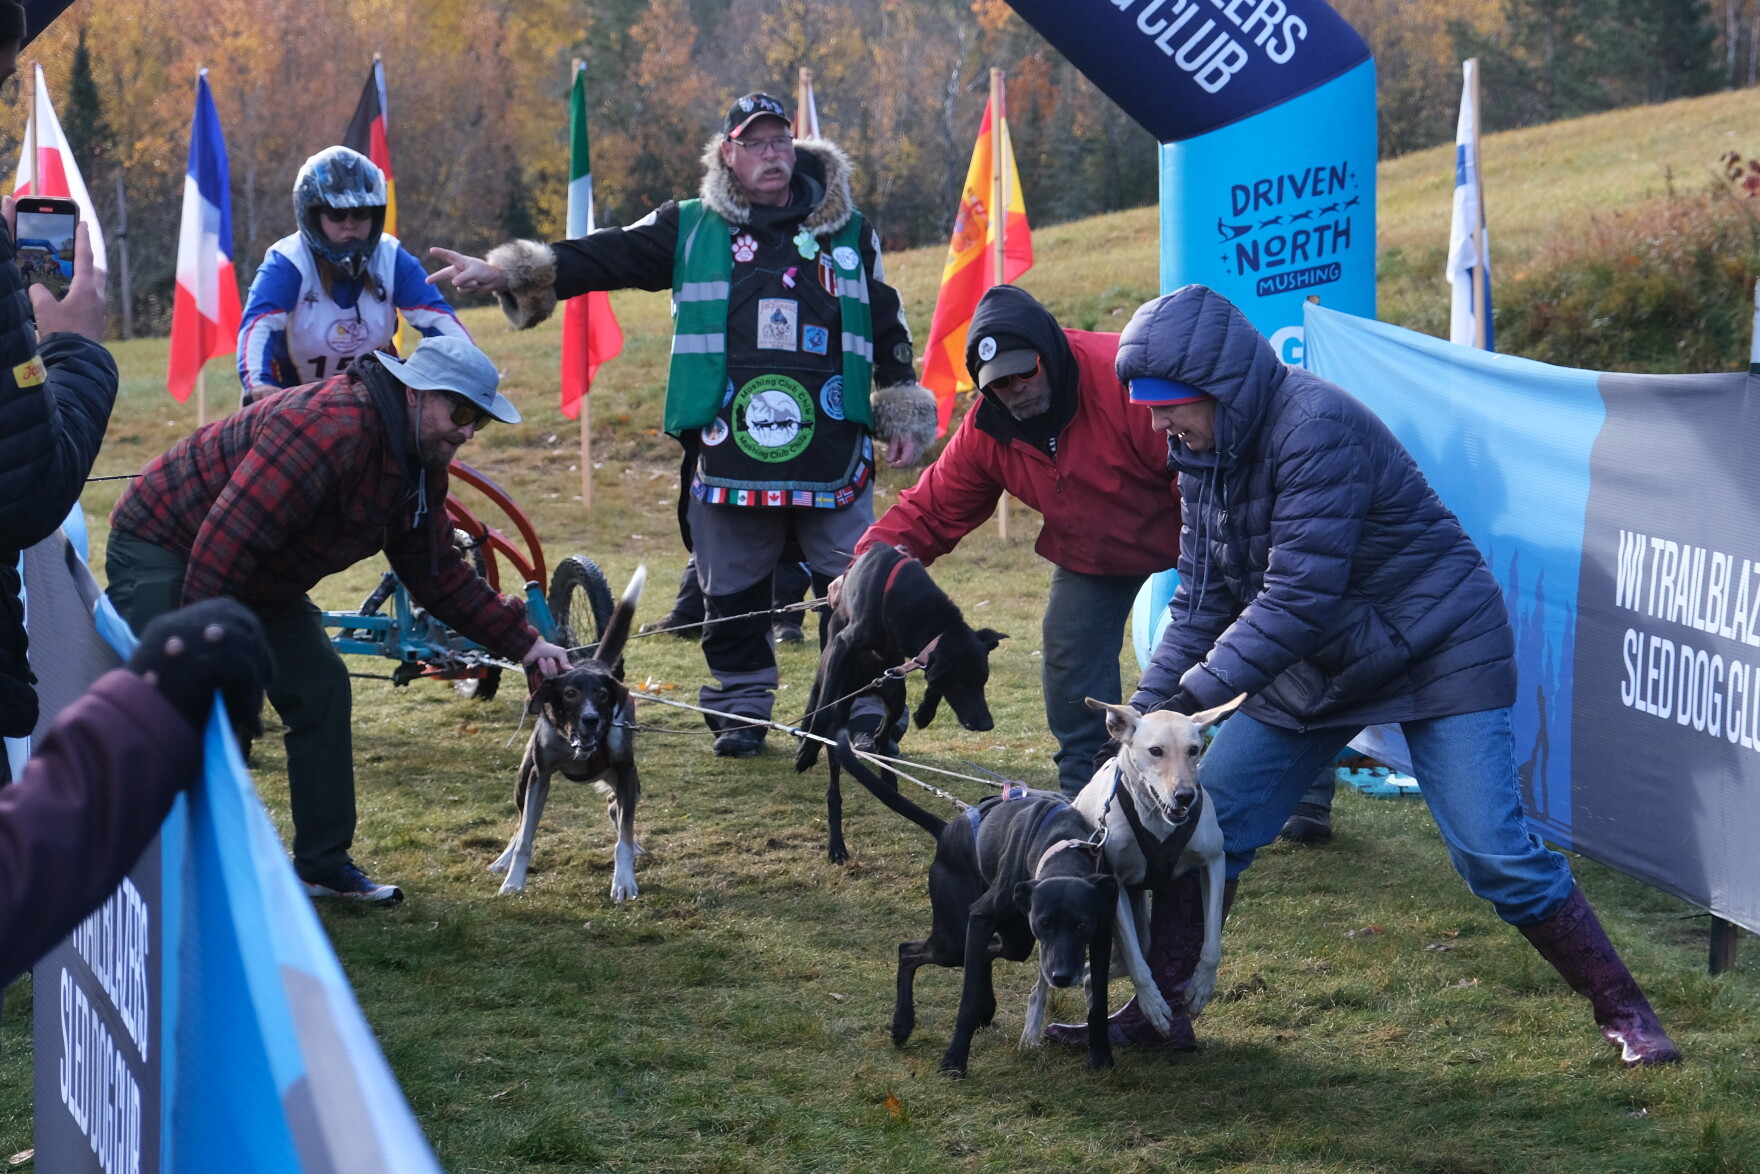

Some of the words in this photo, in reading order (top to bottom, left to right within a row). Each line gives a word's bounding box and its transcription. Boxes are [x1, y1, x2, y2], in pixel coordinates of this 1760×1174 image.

[1136, 0, 1249, 94] CLUB
[1231, 161, 1348, 217] DRIVEN
[1235, 216, 1351, 276] NORTH
[1258, 264, 1341, 294] MUSHING
[740, 379, 776, 399] Mushing
[778, 379, 797, 393] Club
[798, 393, 812, 415] Chile
[739, 436, 769, 460] Mushing
[770, 450, 790, 459] Club
[789, 434, 808, 452] Chile
[1615, 530, 1647, 612] WI
[1621, 628, 1675, 720] SLED
[1677, 644, 1724, 738] DOG
[60, 966, 89, 1135] SLED
[91, 1008, 114, 1174] DOG
